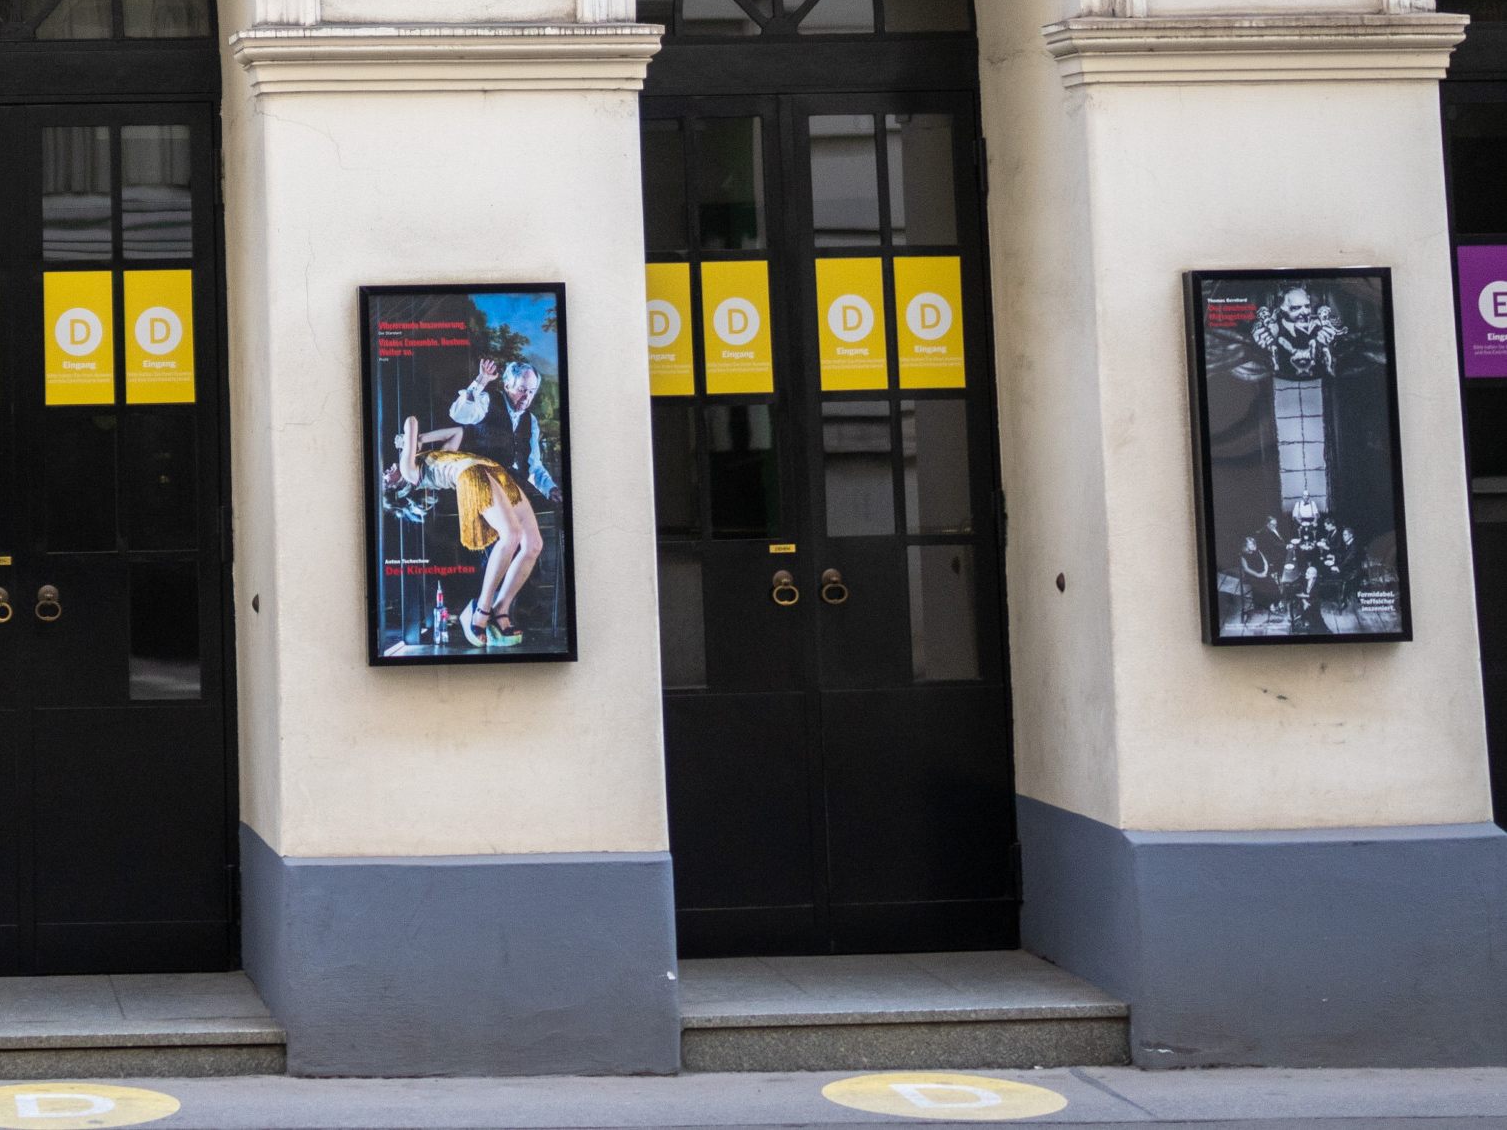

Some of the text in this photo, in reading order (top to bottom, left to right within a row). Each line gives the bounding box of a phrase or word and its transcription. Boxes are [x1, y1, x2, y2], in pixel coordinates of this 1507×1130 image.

[920, 303, 941, 329] D
[1492, 292, 1507, 317] E
[149, 317, 171, 344] D
[649, 310, 670, 337] D
[727, 308, 749, 335] D
[842, 305, 863, 331] D
[69, 319, 91, 345] D
[1487, 333, 1507, 342] Eing
[14, 1093, 116, 1118] D
[888, 1083, 1003, 1109] D
